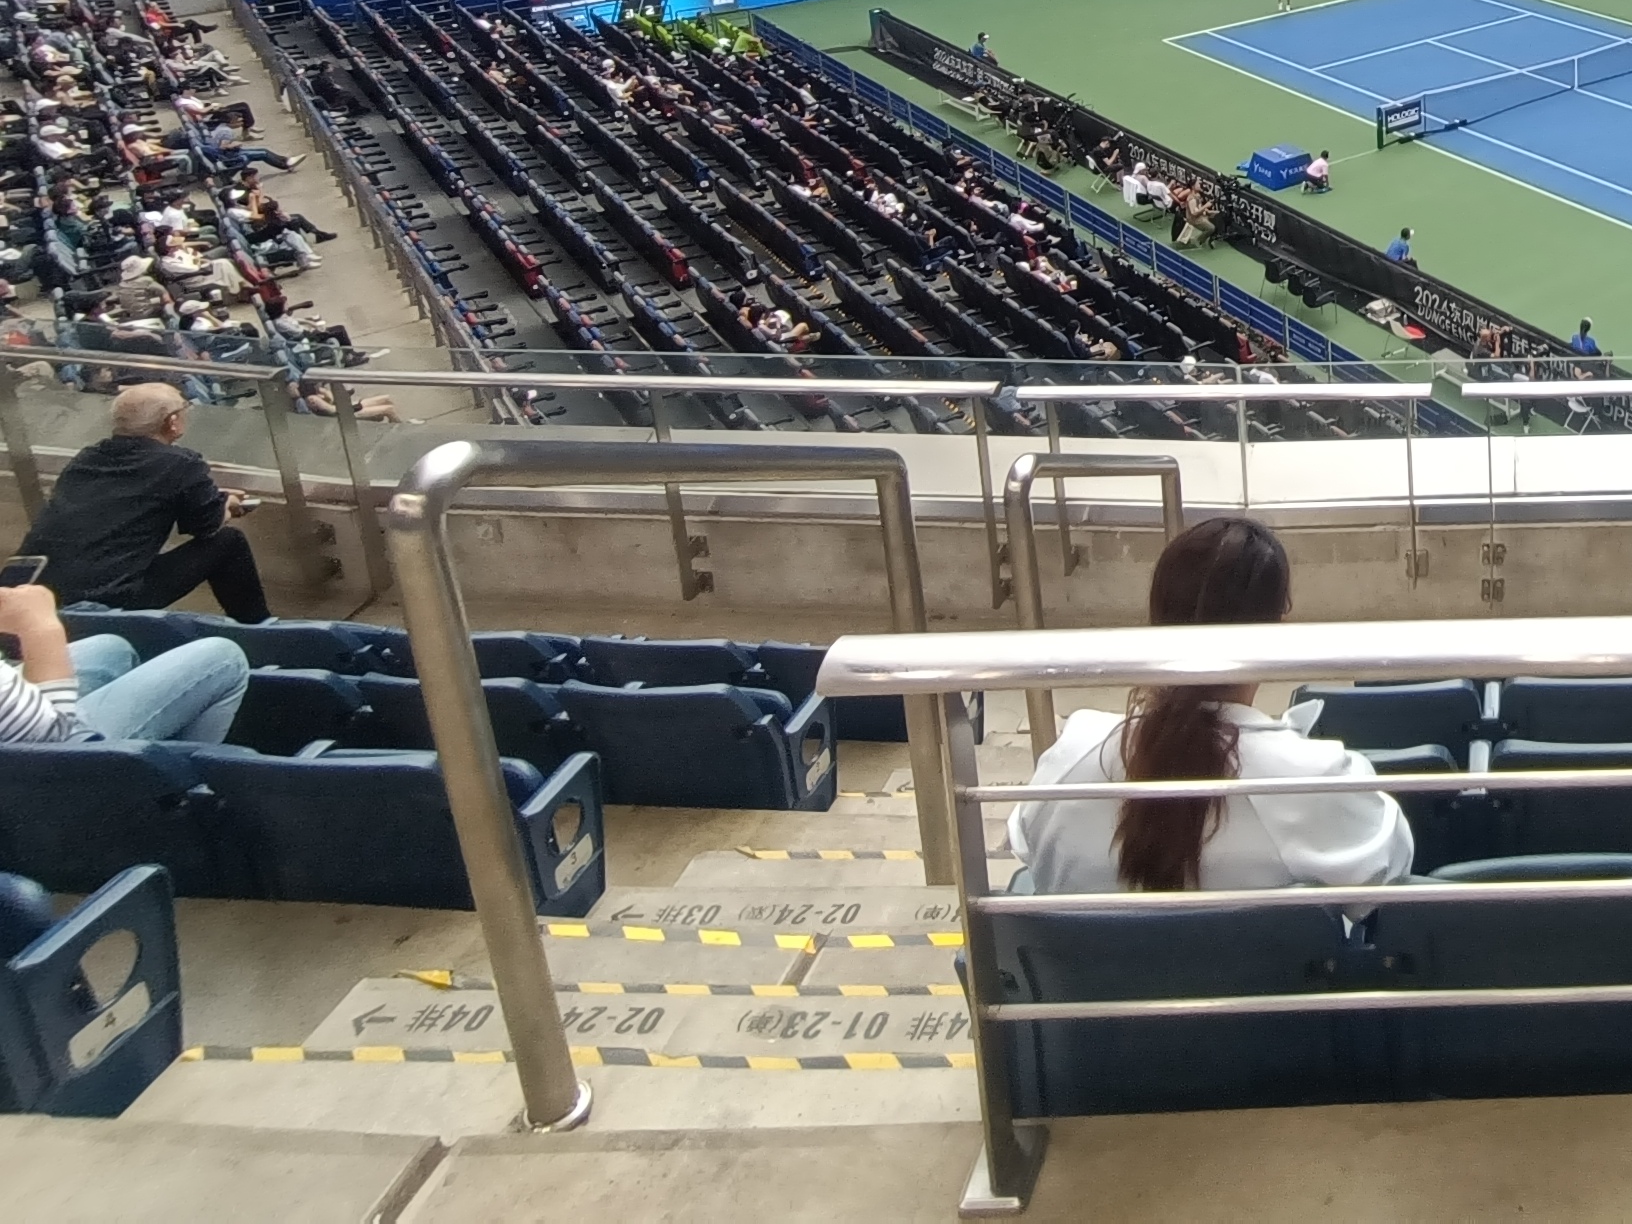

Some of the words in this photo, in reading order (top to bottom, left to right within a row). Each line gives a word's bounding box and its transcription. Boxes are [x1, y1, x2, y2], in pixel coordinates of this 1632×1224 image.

[1388, 107, 1420, 123] HOLOGIC
[1418, 304, 1476, 345] DONGFENG
[653, 904, 721, 925] 03排
[404, 1004, 495, 1033] 04排
[909, 1011, 973, 1042] 4排
